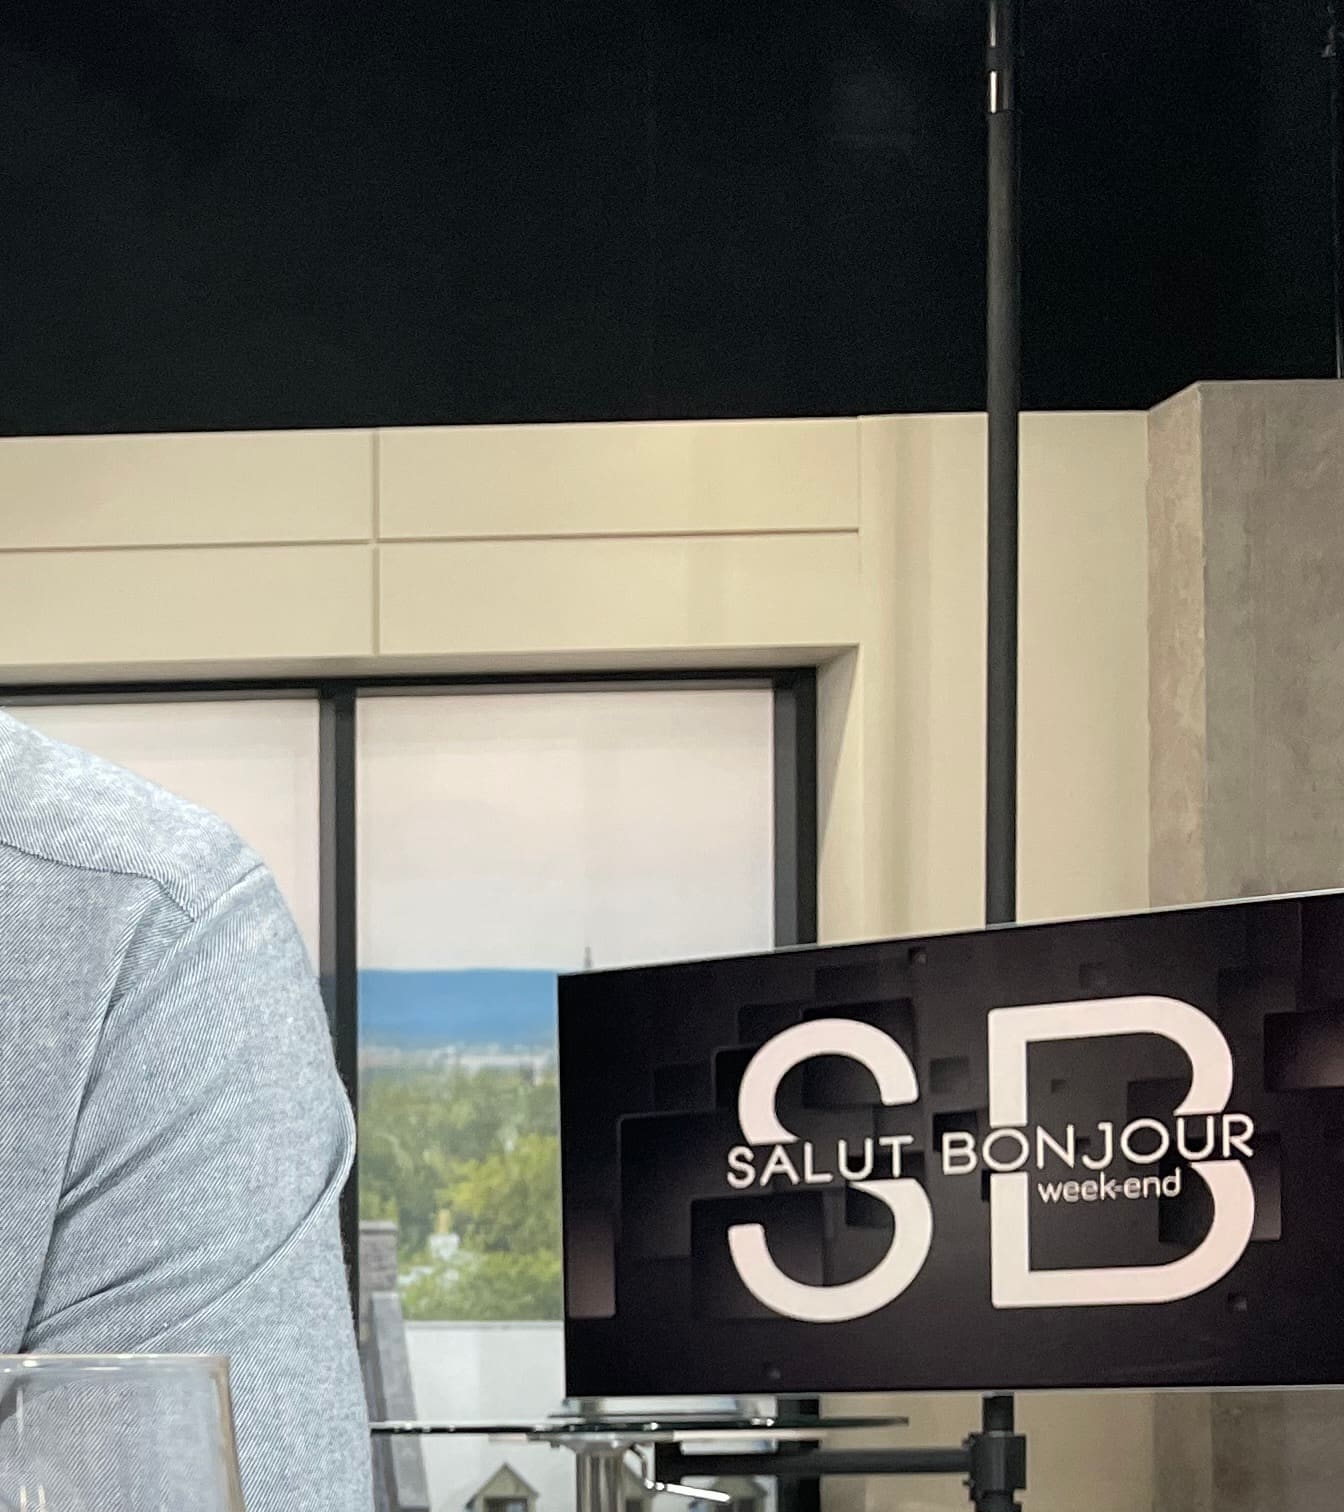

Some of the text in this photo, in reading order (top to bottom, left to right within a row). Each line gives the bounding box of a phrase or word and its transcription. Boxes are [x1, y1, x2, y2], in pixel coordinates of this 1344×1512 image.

[727, 1113, 1255, 1189] SALUT BONJOUR
[1037, 1168, 1182, 1204] week-end
